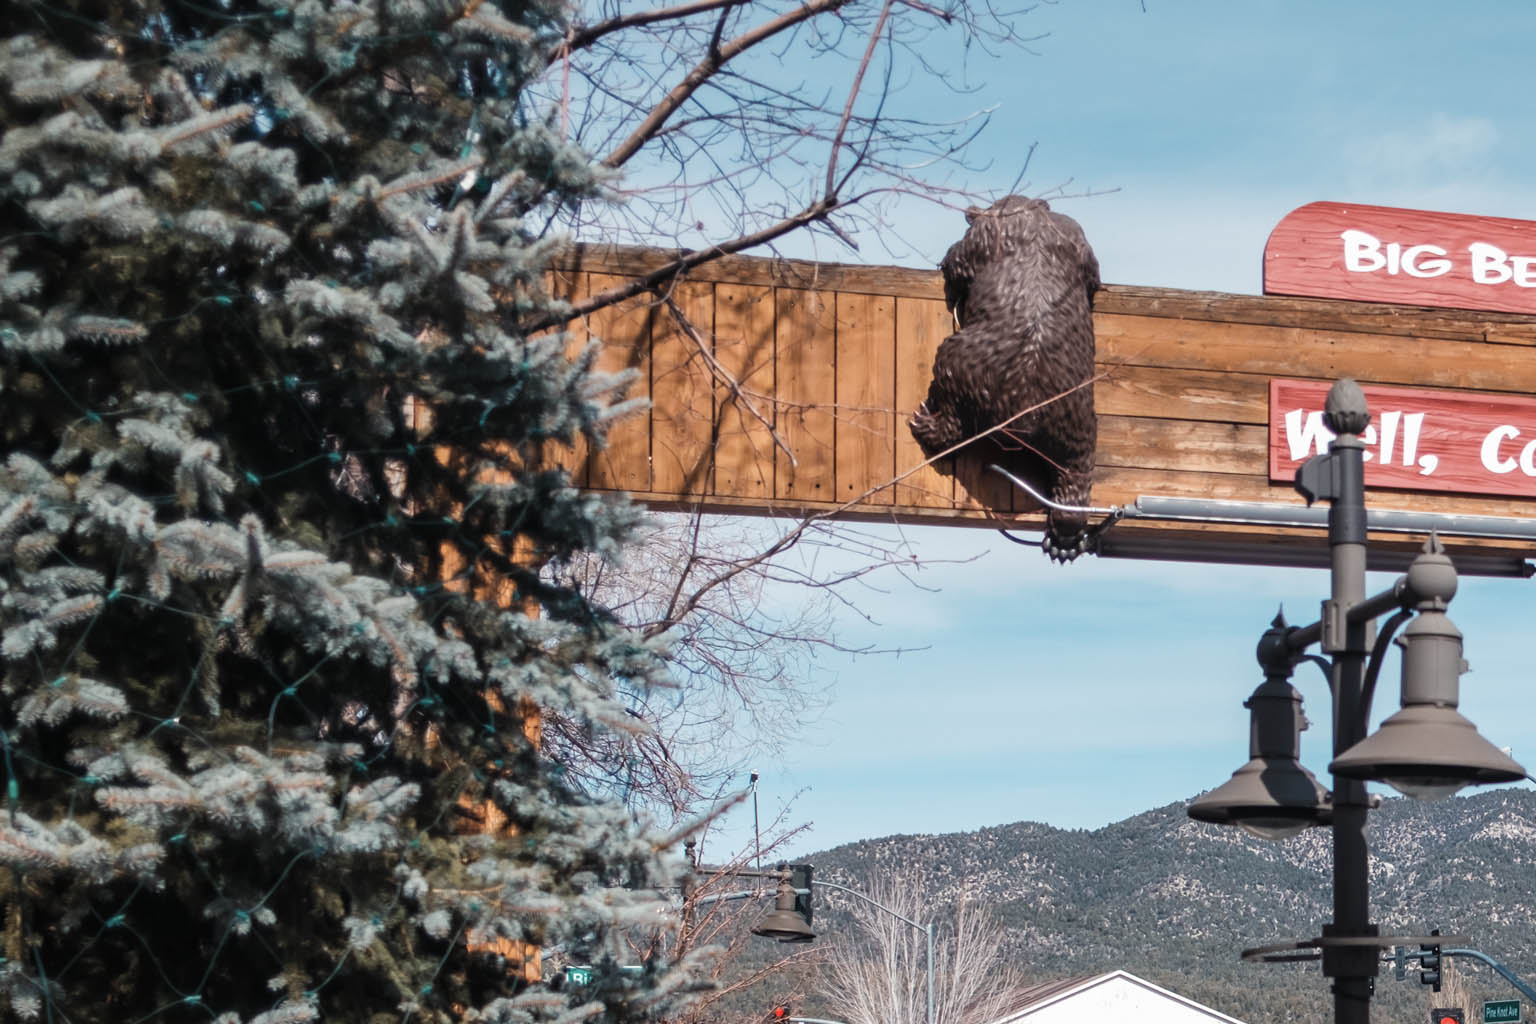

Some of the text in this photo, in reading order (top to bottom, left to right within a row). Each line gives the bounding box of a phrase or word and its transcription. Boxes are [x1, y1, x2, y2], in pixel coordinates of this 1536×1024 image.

[1341, 229, 1453, 278] BIG
[1486, 1004, 1518, 1018] Pine Knot Ave
